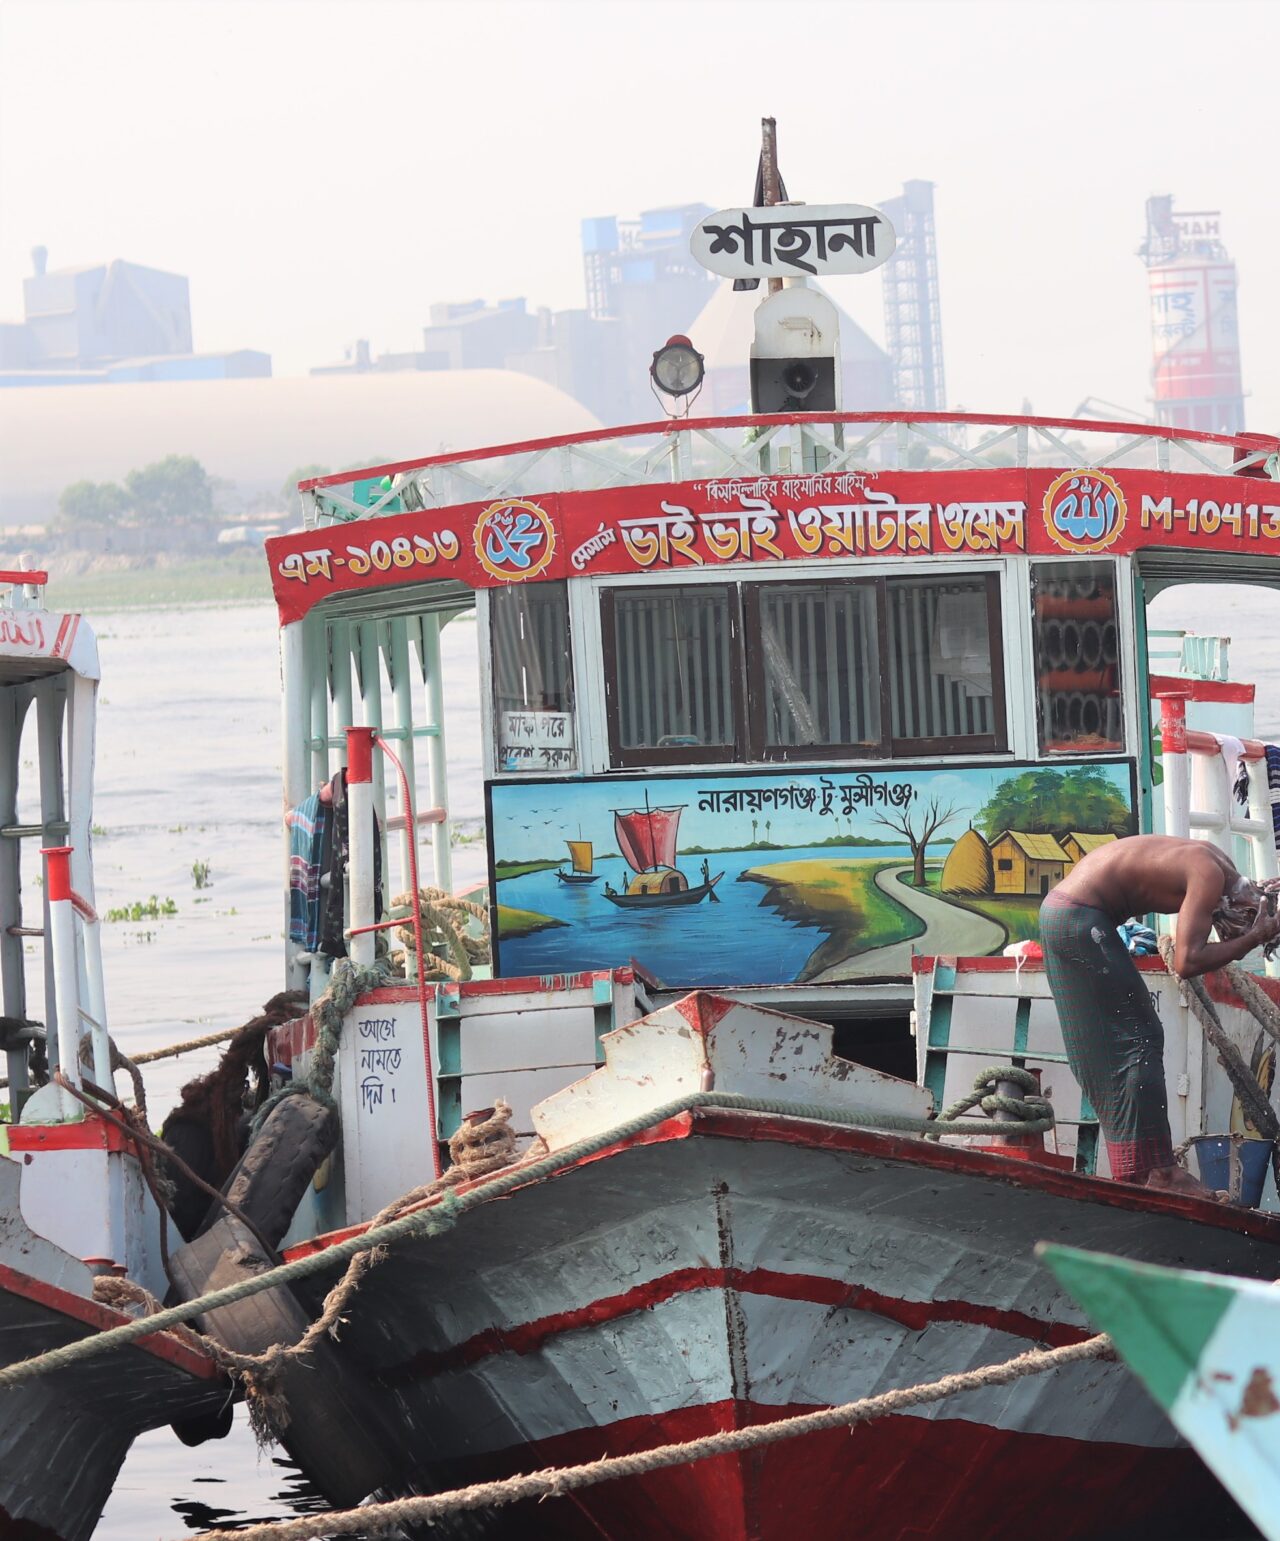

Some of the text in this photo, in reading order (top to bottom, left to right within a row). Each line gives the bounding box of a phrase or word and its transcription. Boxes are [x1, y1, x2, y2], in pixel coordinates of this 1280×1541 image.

[702, 212, 882, 275] শাহানা
[571, 522, 617, 570] মেসার্স
[617, 501, 703, 566] ভাই
[698, 494, 784, 560] ভাই
[787, 487, 932, 554] ওয়াটার
[279, 529, 460, 584] এম-১০৪১৩
[698, 784, 816, 813] নারায়ণগঞ্জ
[819, 776, 837, 816] টু
[358, 1017, 397, 1043] আগে
[361, 1048, 402, 1075] নামতে
